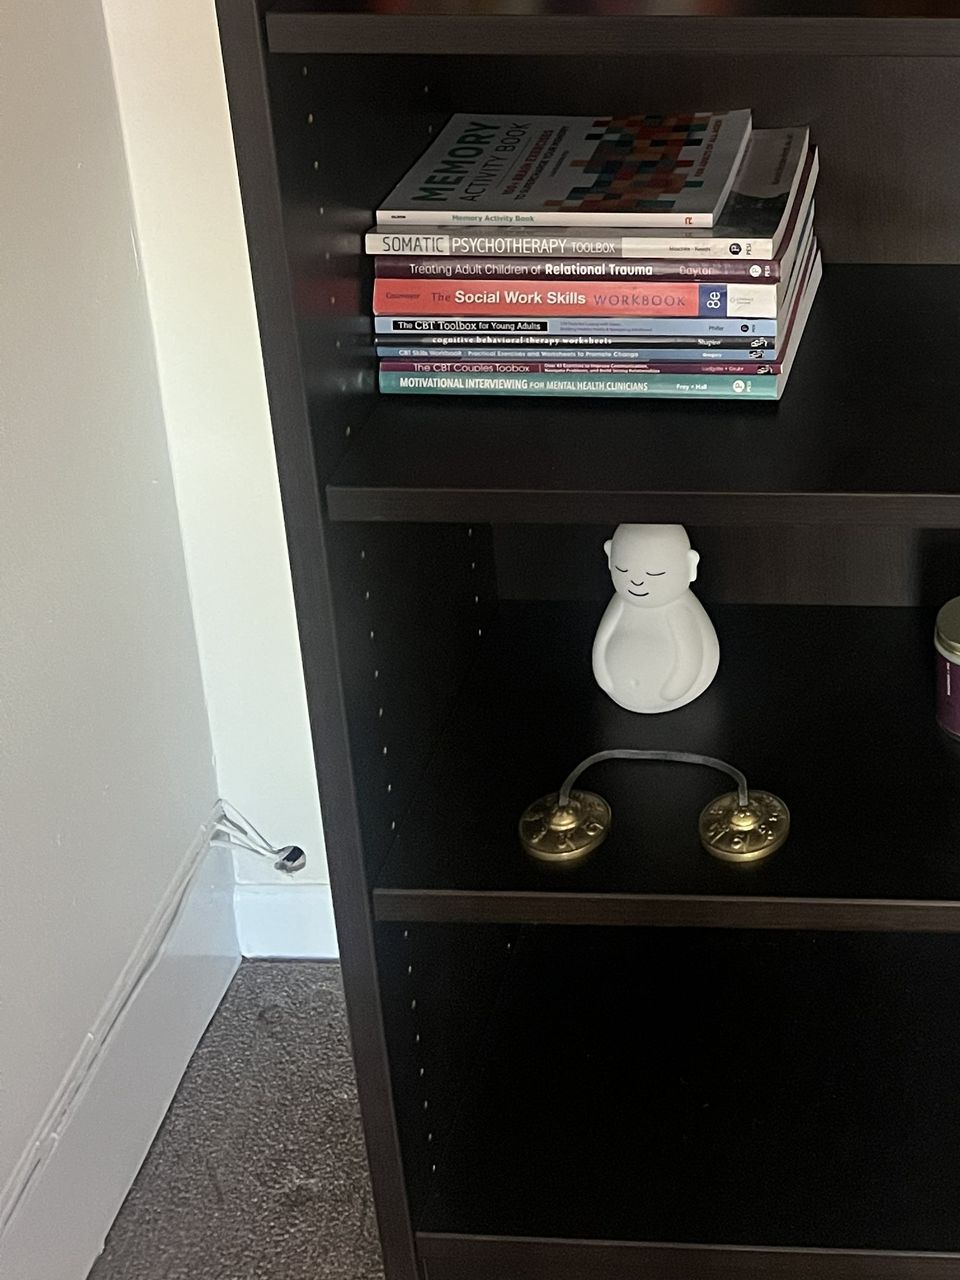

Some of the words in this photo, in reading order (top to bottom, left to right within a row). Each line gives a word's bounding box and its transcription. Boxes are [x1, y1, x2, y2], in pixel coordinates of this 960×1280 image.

[411, 120, 501, 202] MEMORY
[382, 236, 444, 253] SOMATIC
[451, 237, 567, 254] PSYCHOTHERAPY
[409, 263, 452, 277] Treating
[454, 263, 482, 275] Adult
[484, 263, 529, 275] Children
[545, 263, 606, 276] Relational
[608, 263, 653, 276] Trauma
[454, 290, 500, 304] Social
[503, 290, 542, 304] Work
[546, 290, 586, 305] Skills
[593, 294, 687, 306] WORKBOOK
[706, 291, 721, 309] 8e
[414, 320, 435, 330] CBT
[438, 320, 477, 331] Toolbox
[432, 335, 475, 345] cognitive
[476, 335, 523, 345] behavioral
[524, 336, 559, 346] therapy
[560, 336, 613, 345] worksheets
[400, 377, 465, 389] MOTIVATIONAL
[465, 378, 528, 389] INTERVIEWING
[546, 380, 576, 390] MENTAL
[577, 381, 606, 391] HEALTH
[606, 381, 649, 392] CLINICIANS
